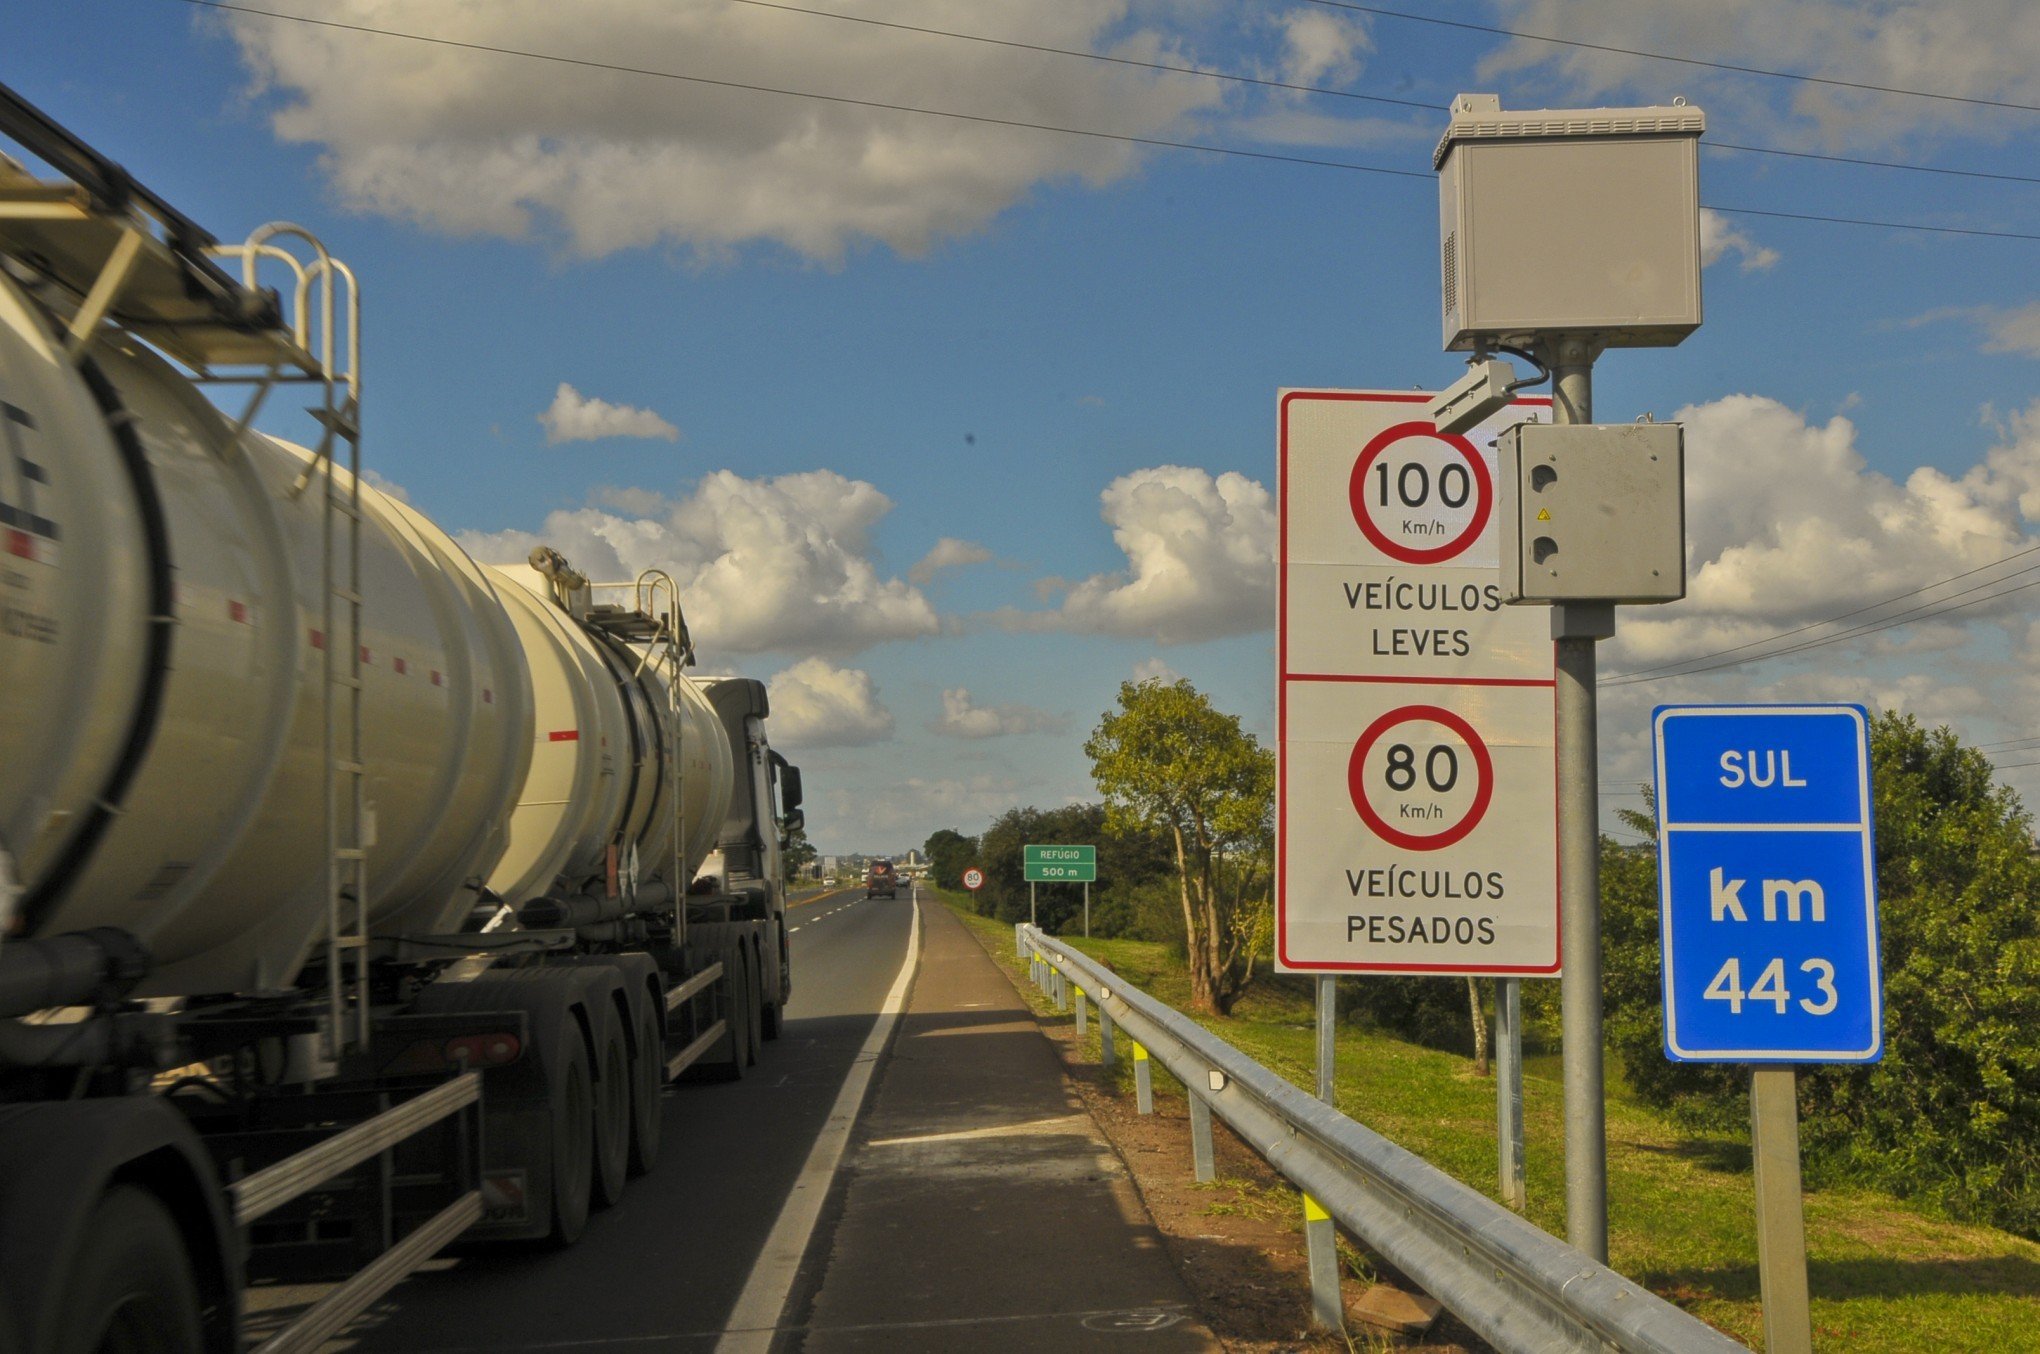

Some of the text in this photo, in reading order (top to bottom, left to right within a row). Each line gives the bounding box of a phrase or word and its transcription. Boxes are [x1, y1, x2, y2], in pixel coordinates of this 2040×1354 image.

[1376, 462, 1470, 509] 100
[1402, 519, 1445, 536] Km/h
[1343, 576, 1501, 612] VEÍCULOS
[1372, 628, 1470, 657] LEVES
[1385, 743, 1459, 793] 80
[1719, 750, 1807, 788] SUL
[1399, 802, 1443, 820] Km/h
[1040, 847, 1080, 859] REFÚGIO
[967, 872, 980, 882] 80
[1042, 867, 1078, 877] 500 m
[1345, 864, 1504, 900] VEÍCULOS
[1709, 866, 1825, 922] km
[1347, 915, 1495, 945] PESADOS
[1702, 957, 1838, 1016] 443
